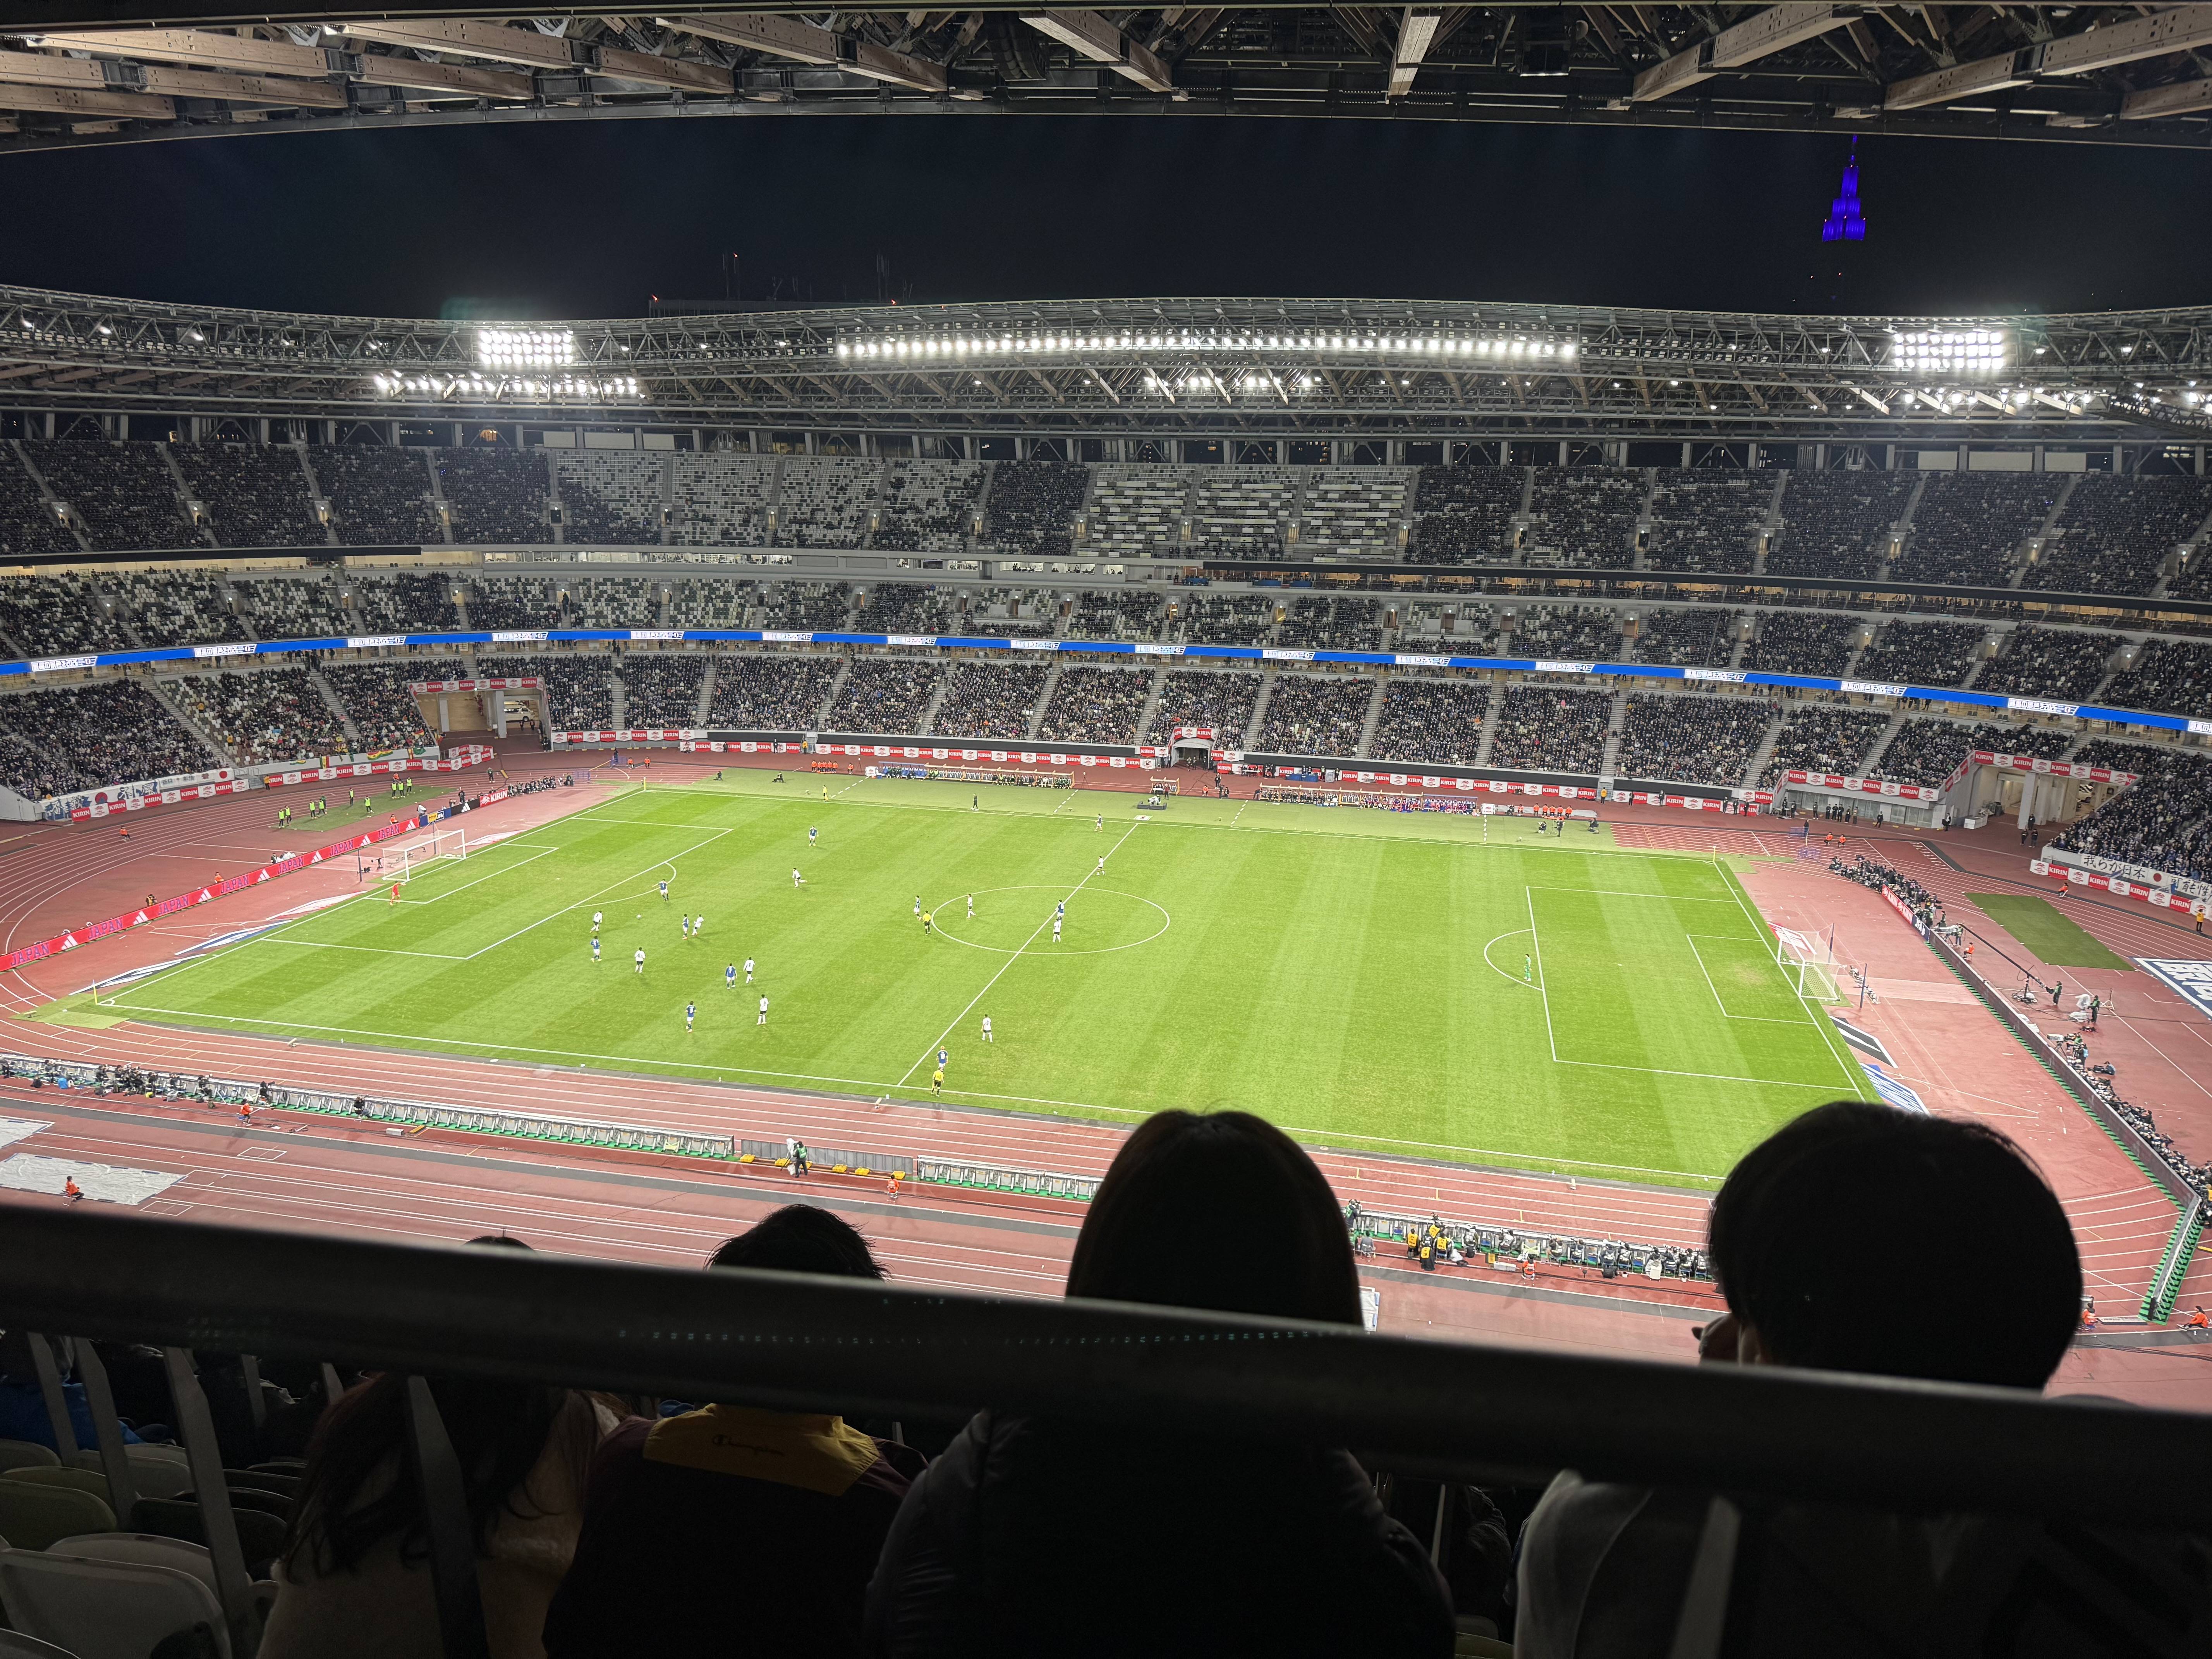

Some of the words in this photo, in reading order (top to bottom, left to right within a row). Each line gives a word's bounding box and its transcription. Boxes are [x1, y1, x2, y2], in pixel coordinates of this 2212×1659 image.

[490, 790, 507, 802] KIRIN
[378, 824, 399, 840] JAPAN
[330, 840, 353, 856] JAPAN
[277, 857, 304, 874] JAPAN
[2049, 867, 2067, 876] KIRIN
[2083, 856, 2145, 879] 我らが日本
[221, 876, 248, 893] JAPAN
[2089, 878, 2108, 886] KIRIN
[2130, 887, 2148, 896] KIRIN
[158, 896, 189, 914] JAPAN
[2171, 899, 2190, 908] KIRIN
[88, 917, 124, 939] JAPAN
[10, 943, 50, 966] JAPAN
[713, 1434, 785, 1457] Champion
